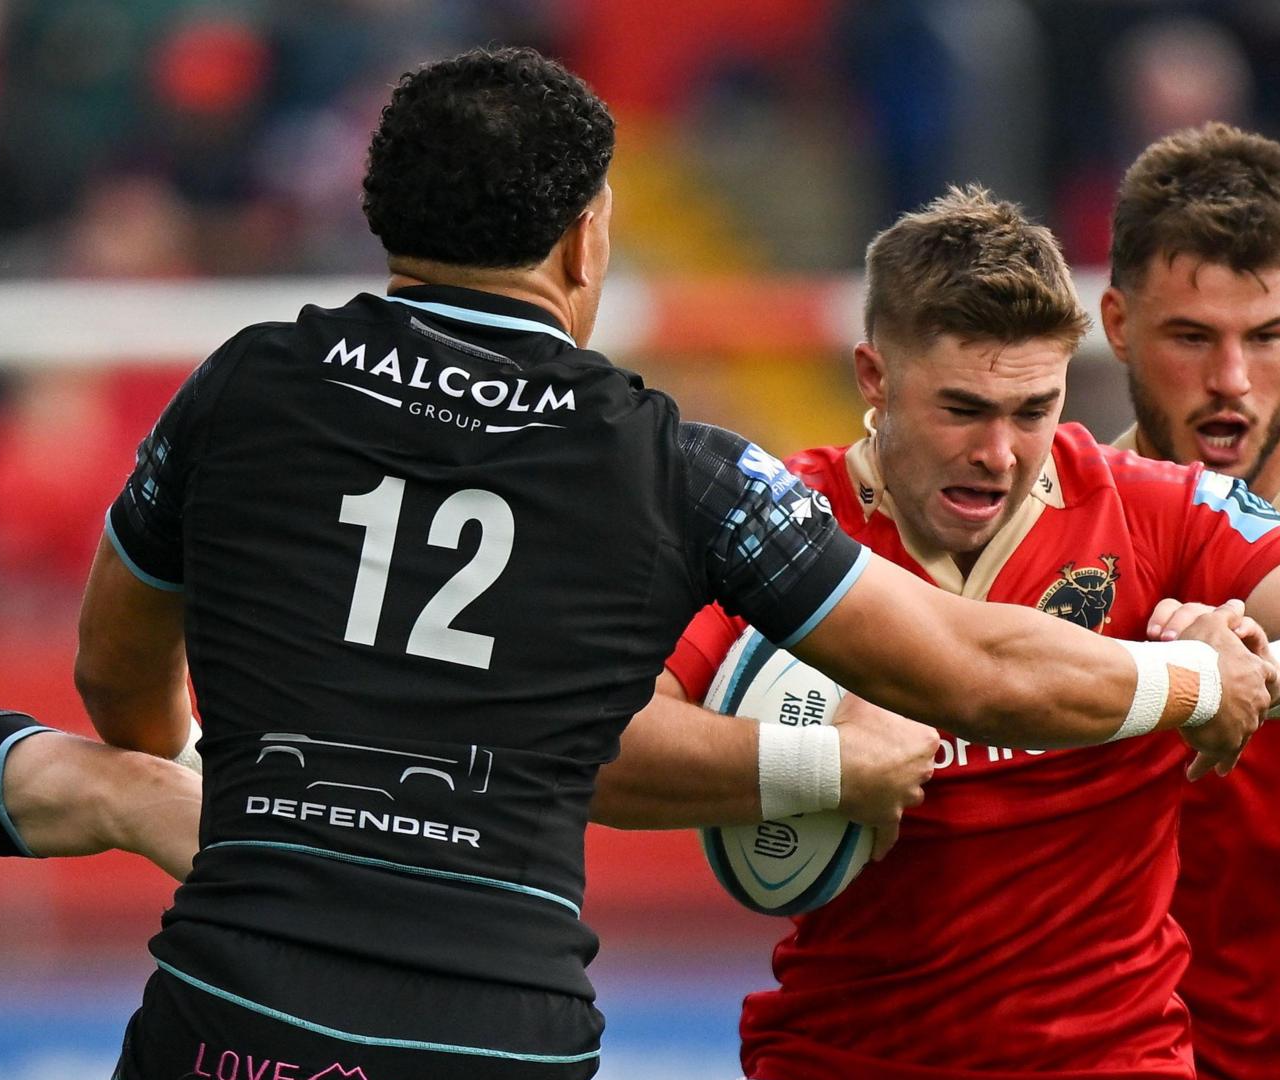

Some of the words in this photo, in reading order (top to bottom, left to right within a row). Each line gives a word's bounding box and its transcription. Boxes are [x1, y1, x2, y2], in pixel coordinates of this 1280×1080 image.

[322, 337, 576, 414] MALCOLM
[408, 402, 481, 432] GROUP
[338, 475, 515, 670] 12
[1037, 580, 1065, 609] UNSTER
[245, 795, 482, 849] DEFENDER
